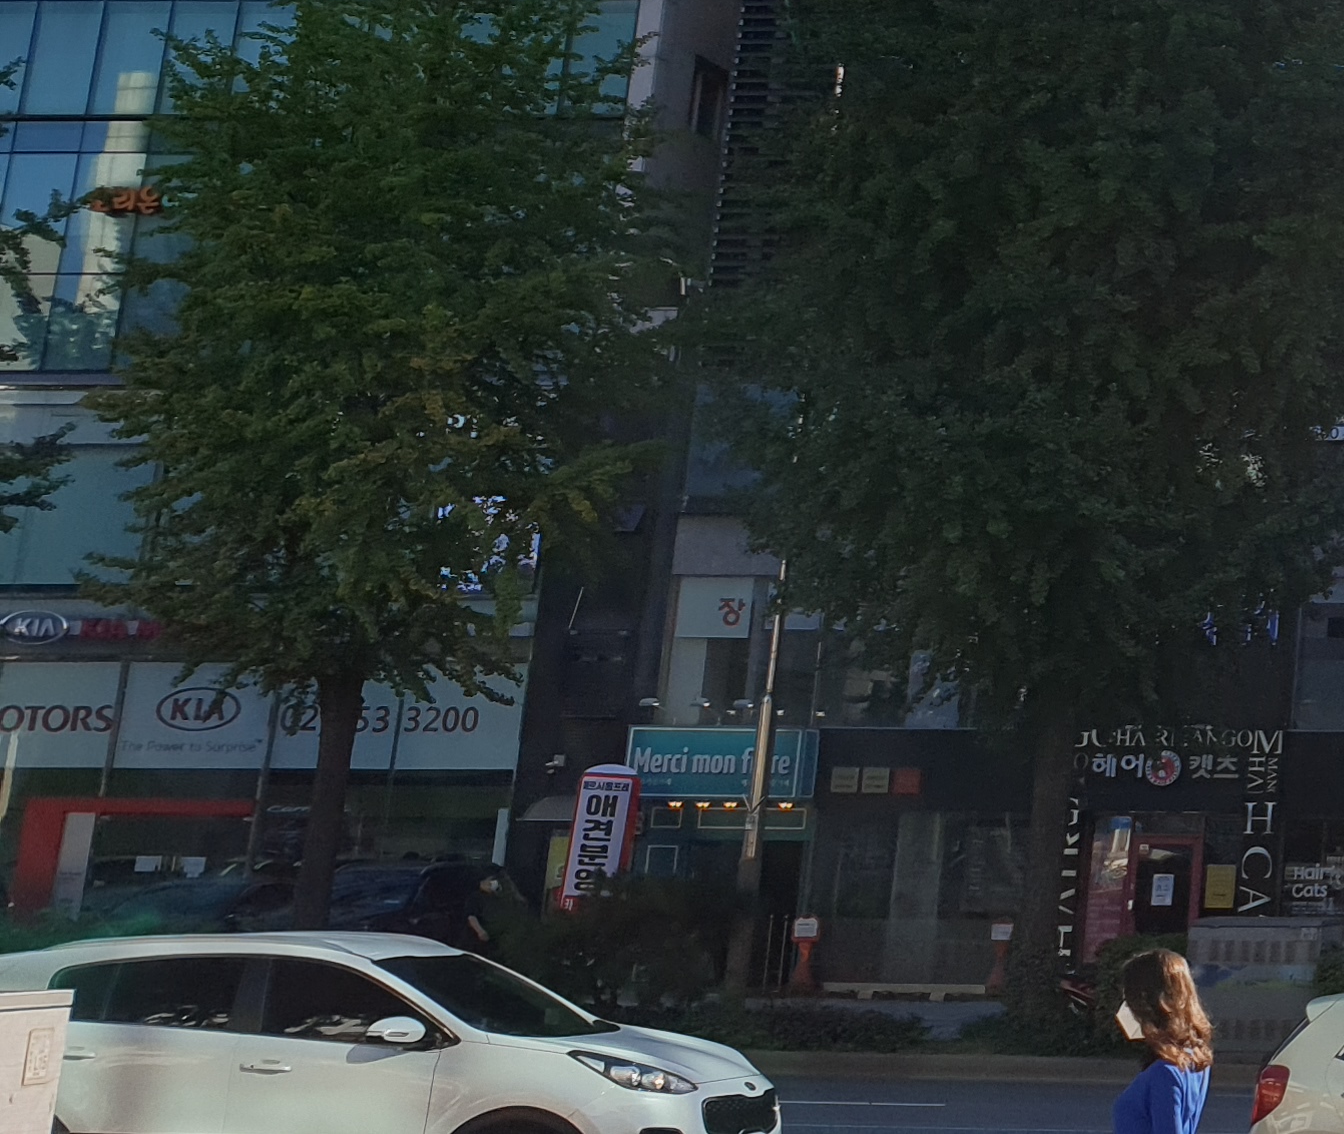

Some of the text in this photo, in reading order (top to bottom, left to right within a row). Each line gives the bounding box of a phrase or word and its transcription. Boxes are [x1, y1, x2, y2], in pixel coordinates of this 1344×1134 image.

[13, 617, 55, 636] KIA
[169, 697, 226, 723] KIA
[404, 705, 480, 733] 3200
[634, 746, 791, 775] Merci mon fre
[1092, 753, 1144, 778] 헤어
[1292, 883, 1328, 898] Cats
